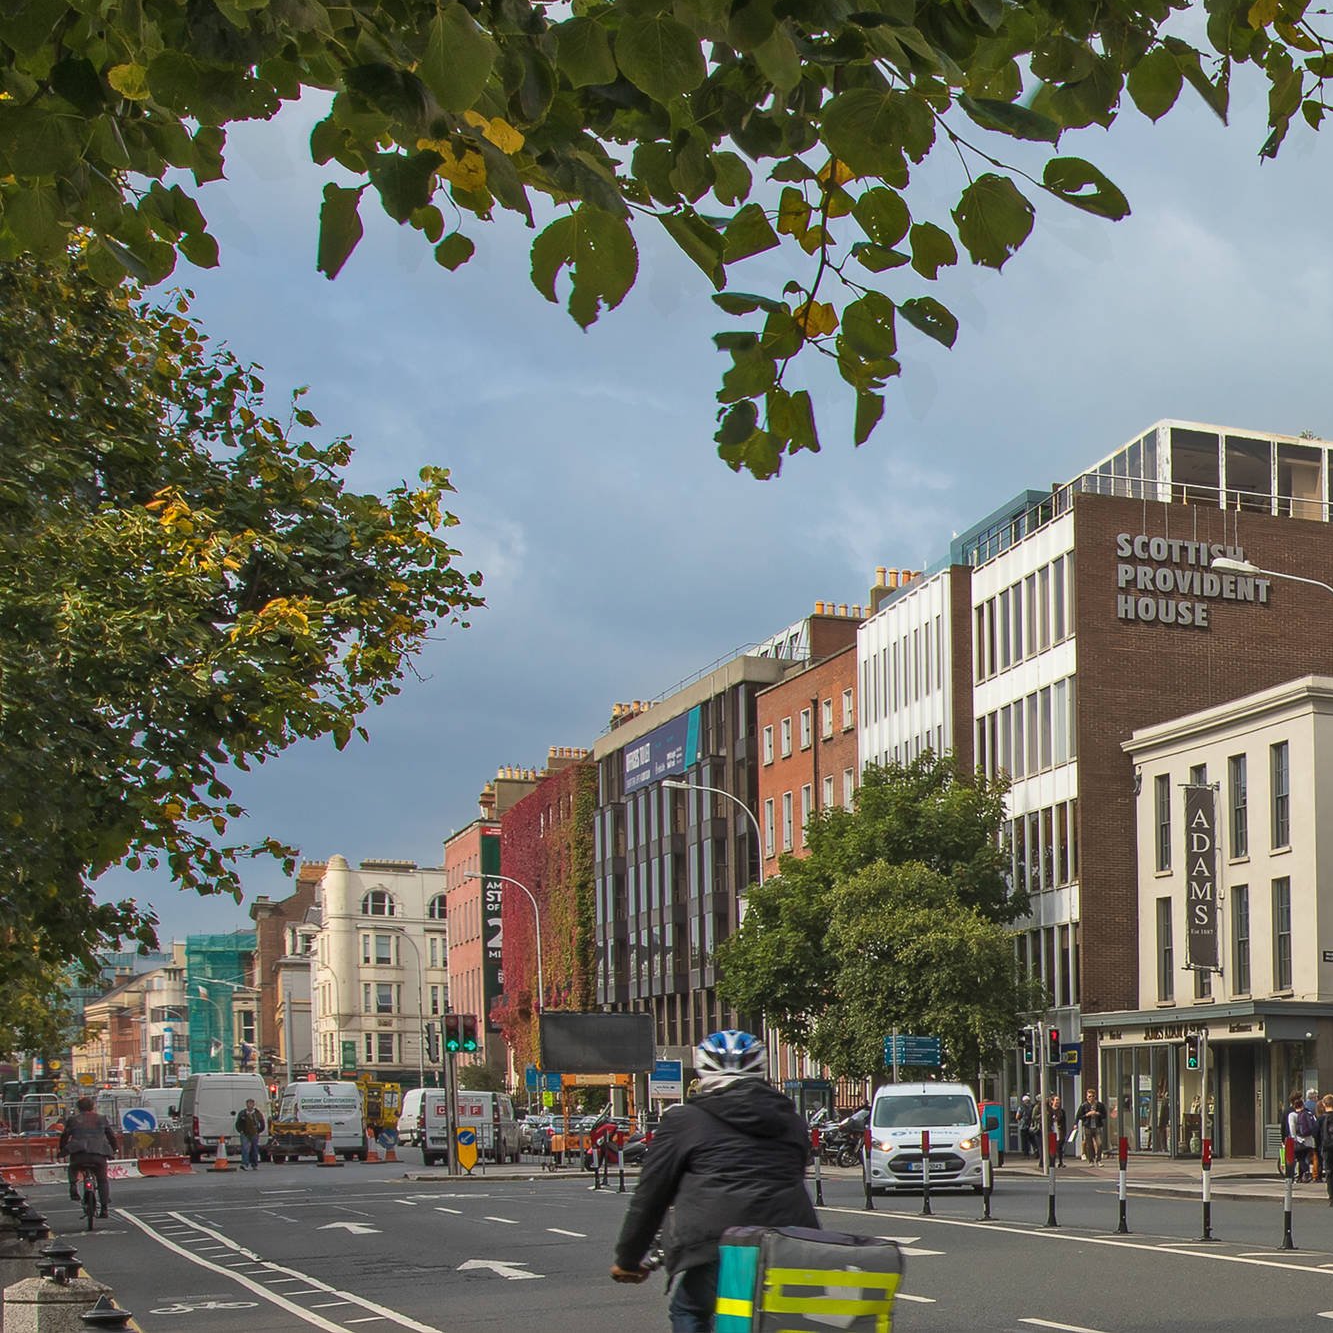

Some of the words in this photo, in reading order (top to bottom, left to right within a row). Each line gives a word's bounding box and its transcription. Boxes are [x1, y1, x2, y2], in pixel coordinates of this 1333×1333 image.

[1117, 533, 1244, 567] SCOTTISH
[1117, 563, 1271, 603] PROVIDENT
[1117, 594, 1209, 627] HOUSE
[1190, 808, 1213, 925] ADAMS
